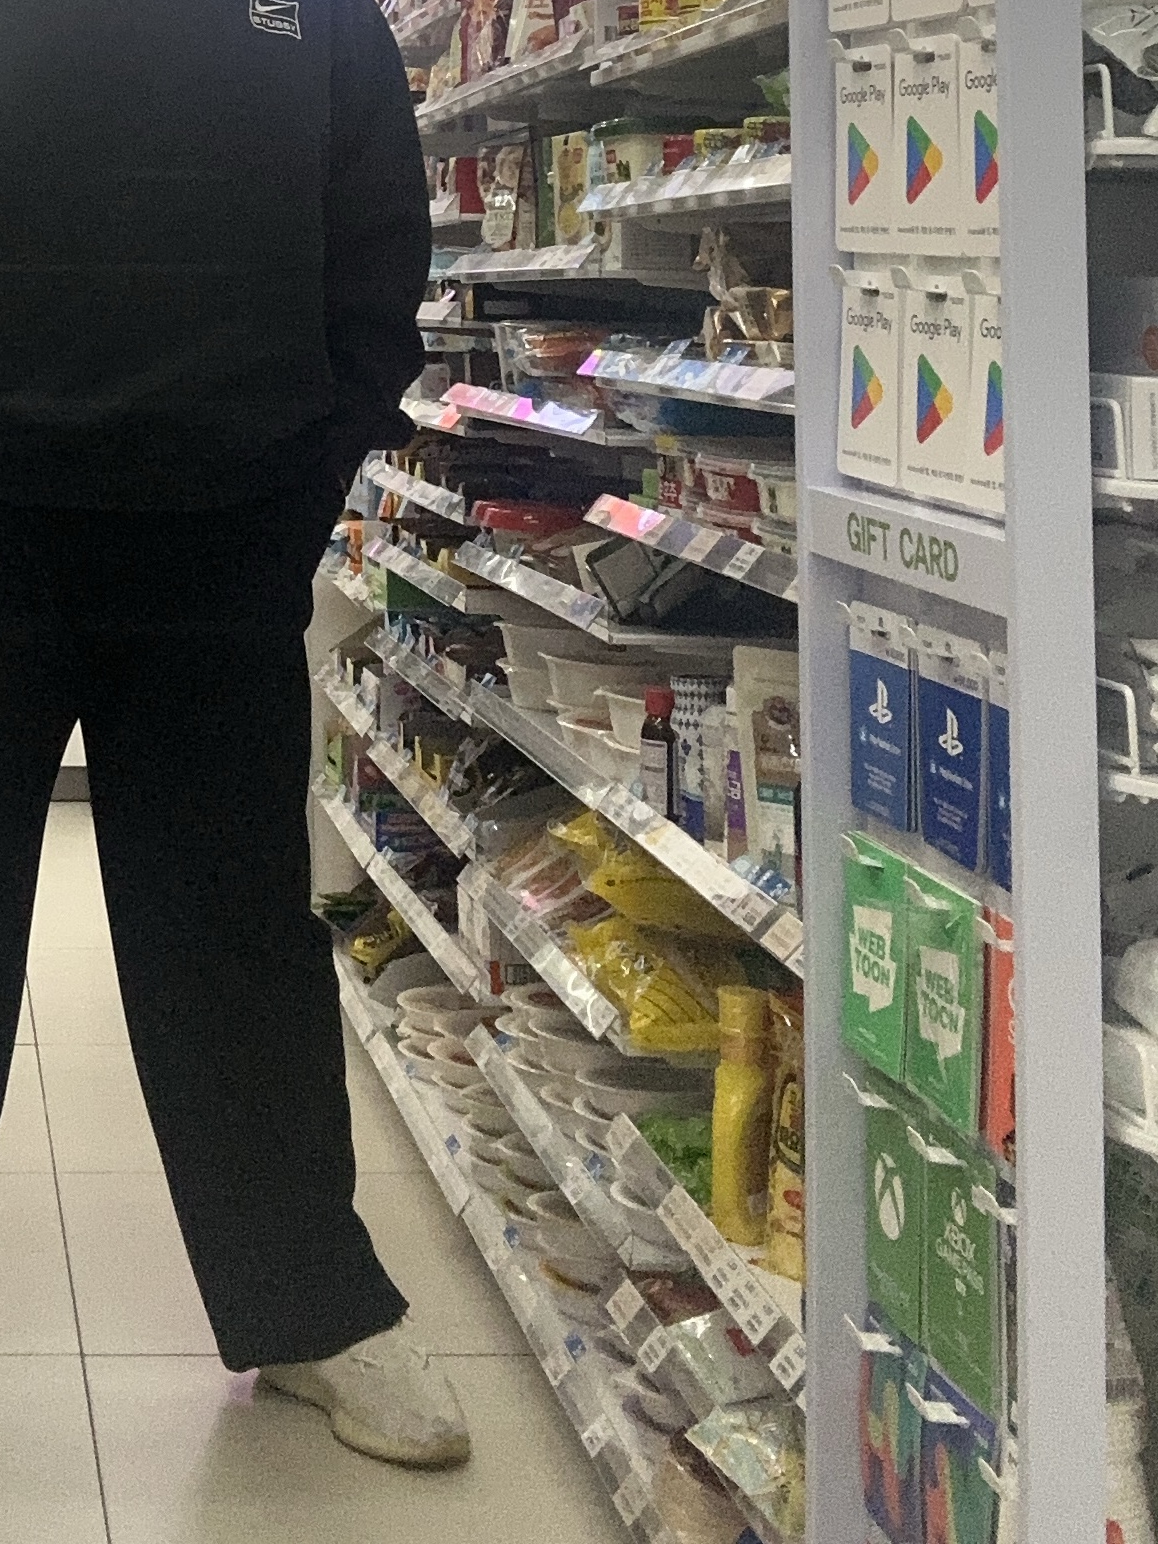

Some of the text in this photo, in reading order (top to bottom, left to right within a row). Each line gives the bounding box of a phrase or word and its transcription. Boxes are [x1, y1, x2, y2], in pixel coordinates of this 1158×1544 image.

[898, 77, 930, 101] Google
[910, 313, 942, 341] Google
[847, 512, 959, 583] GIFT CARD
[857, 926, 886, 961] WEB
[854, 946, 891, 989] TOON
[924, 969, 955, 1005] WEB
[920, 989, 960, 1034] TOON
